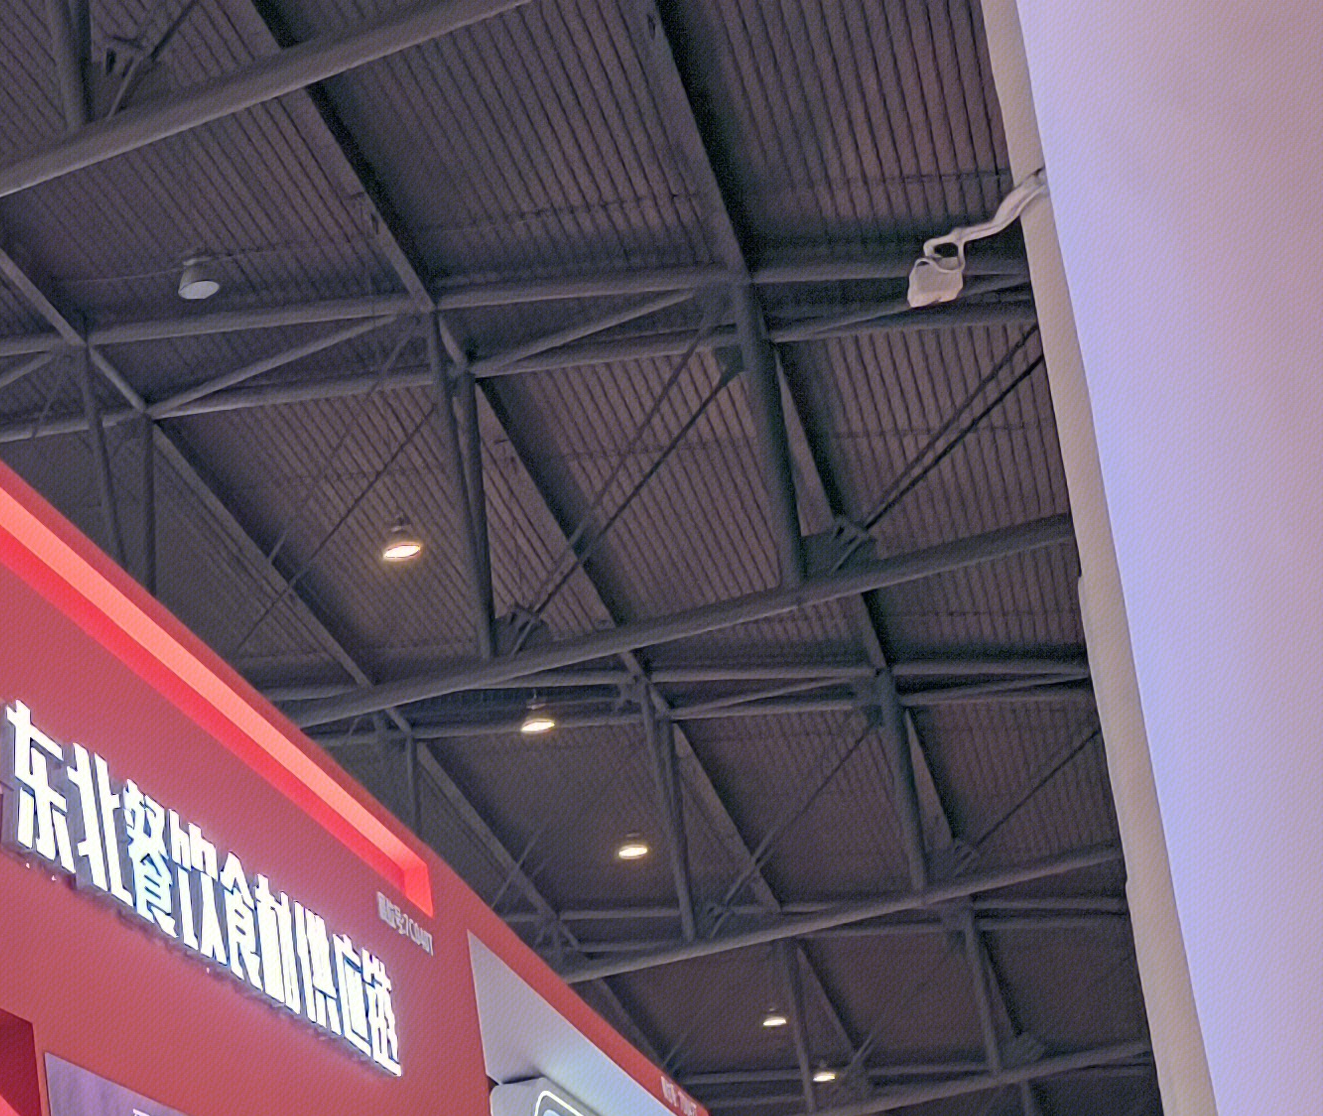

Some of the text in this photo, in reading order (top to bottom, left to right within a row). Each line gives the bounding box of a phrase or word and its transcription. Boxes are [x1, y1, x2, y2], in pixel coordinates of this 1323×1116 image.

[0, 698, 402, 1078] 东北餐饮食材供应链
